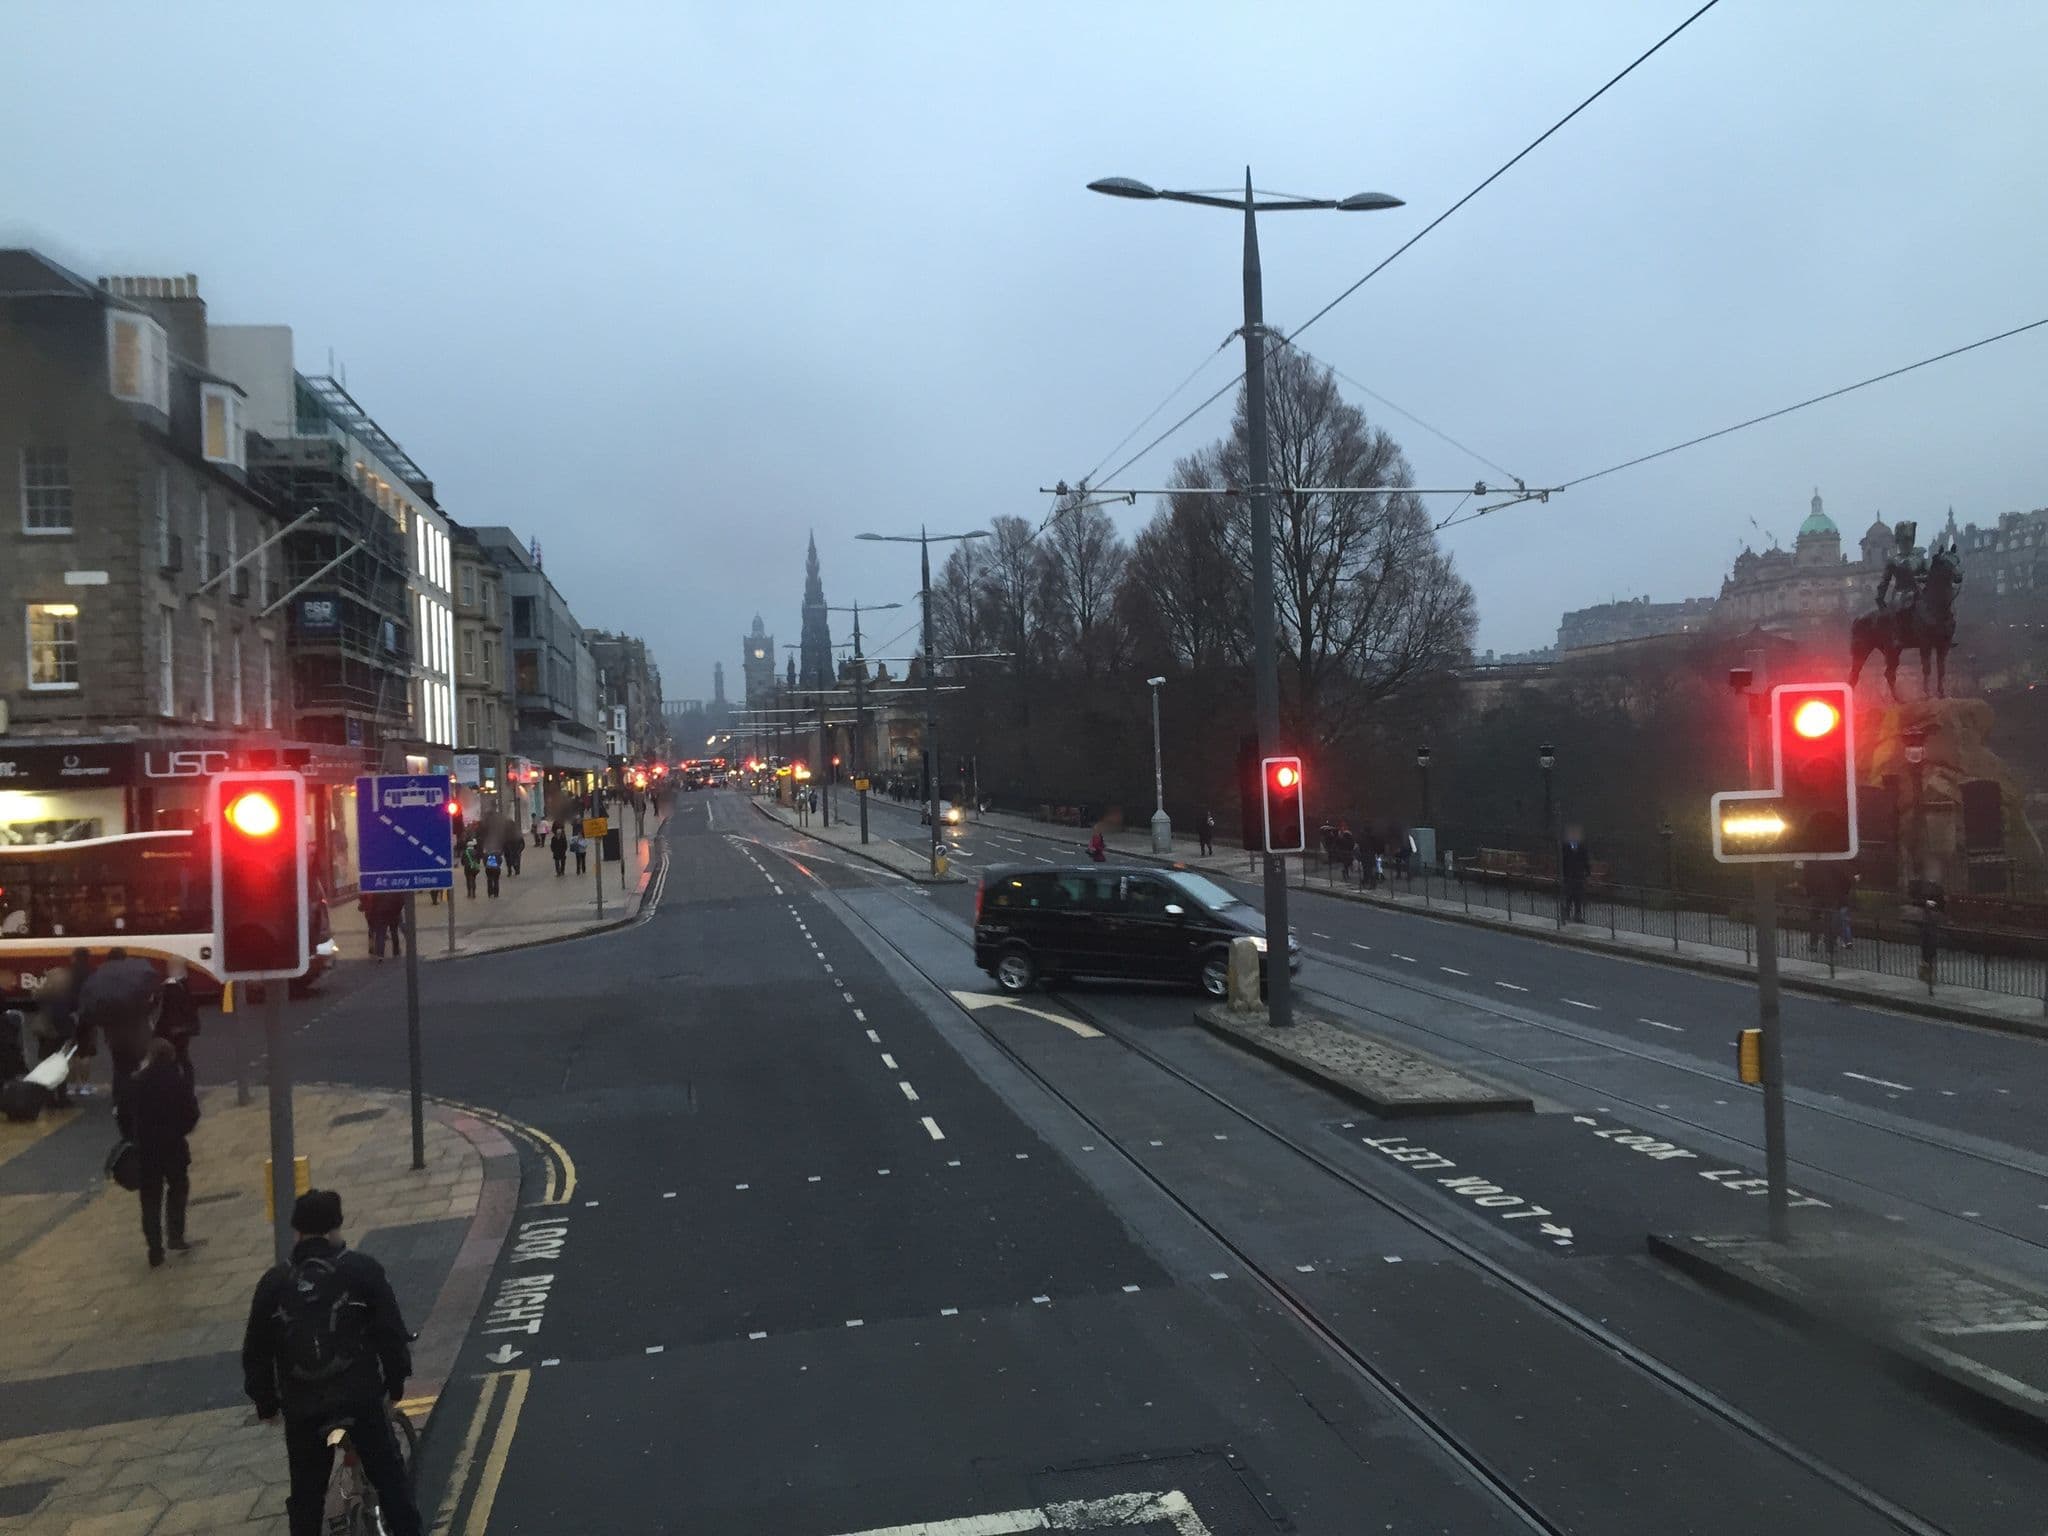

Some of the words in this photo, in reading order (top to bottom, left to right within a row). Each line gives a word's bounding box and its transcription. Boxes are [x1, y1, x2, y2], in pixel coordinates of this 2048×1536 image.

[144, 750, 230, 777] USC
[374, 877, 388, 887] At
[391, 876, 410, 888] any
[413, 874, 438, 886] time
[1362, 1137, 1456, 1169] LEFT
[1593, 1128, 1698, 1160] LOOK
[1437, 1176, 1552, 1219] LOOK
[511, 1217, 570, 1263] LOOK
[481, 1274, 555, 1335] RIGHT
